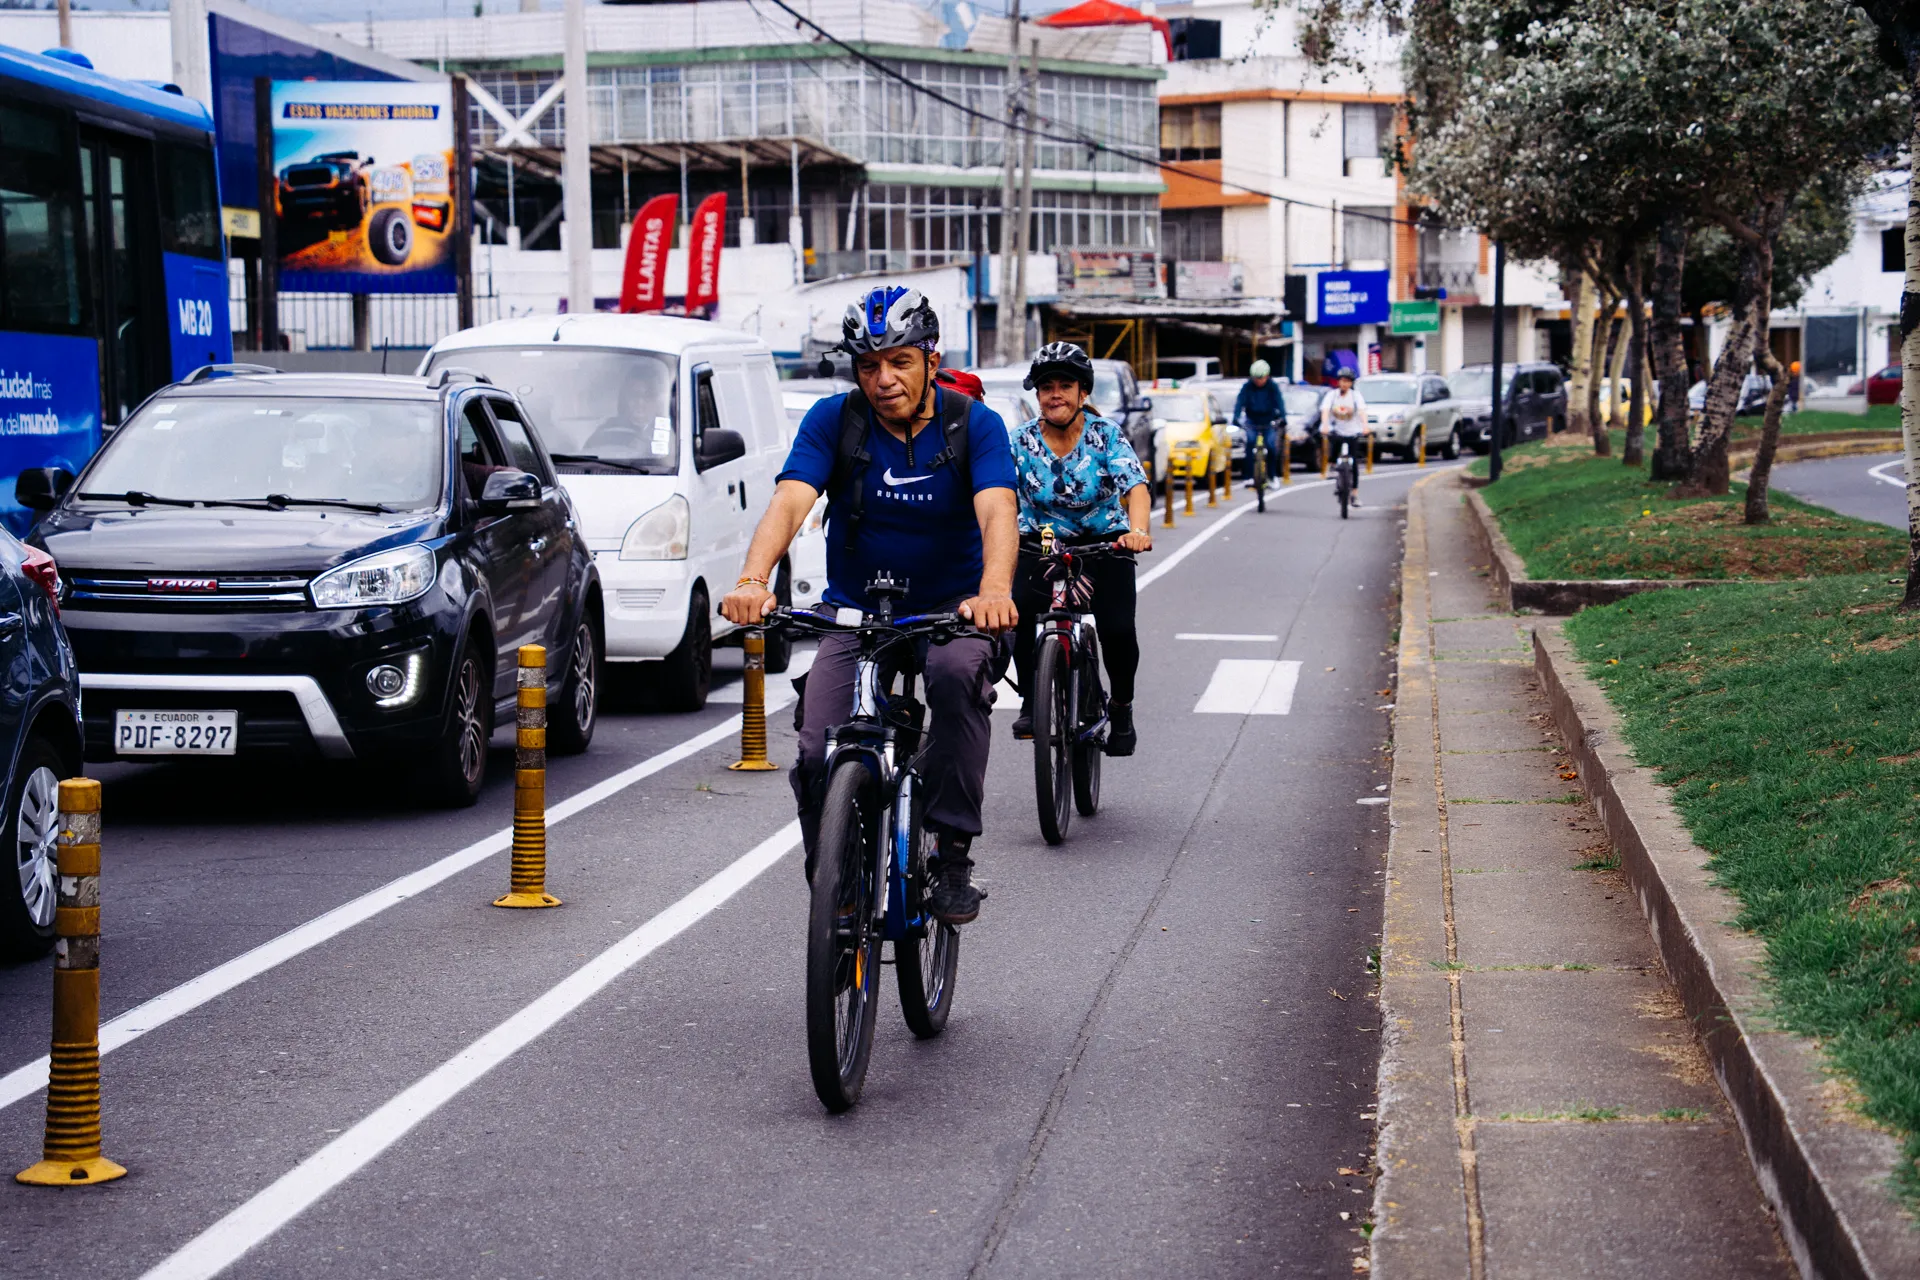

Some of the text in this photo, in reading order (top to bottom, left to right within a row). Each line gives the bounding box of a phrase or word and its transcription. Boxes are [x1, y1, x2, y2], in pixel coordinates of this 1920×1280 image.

[636, 218, 664, 302] LLANTAS
[698, 211, 719, 296] BATERIAS
[20, 407, 59, 435] mundo
[877, 490, 933, 501] RUNNING
[154, 713, 199, 722] ECUADOR
[120, 726, 232, 749] PDF-8297
